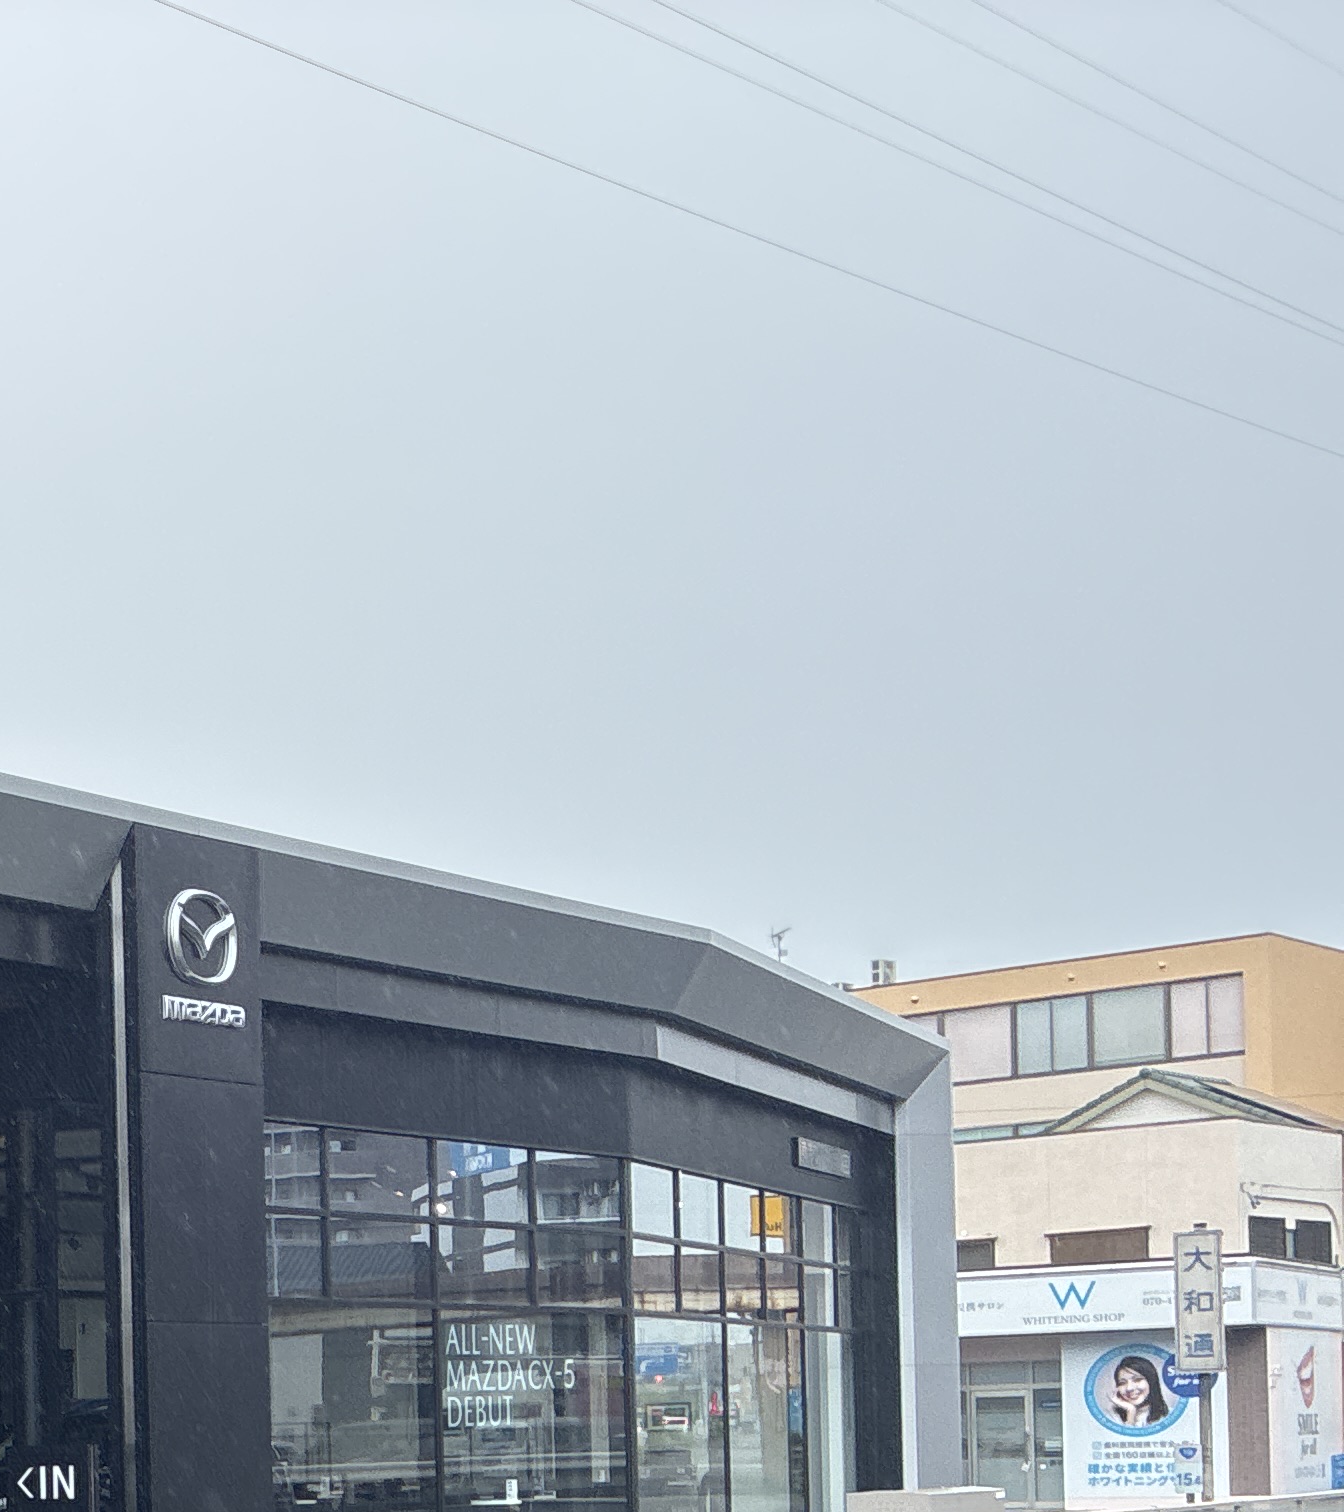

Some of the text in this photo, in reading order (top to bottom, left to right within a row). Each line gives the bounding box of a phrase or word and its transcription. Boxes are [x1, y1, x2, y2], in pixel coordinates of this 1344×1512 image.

[162, 995, 247, 1028] mazda
[1048, 1280, 1097, 1311] W
[1183, 1246, 1215, 1358] 大和通
[1023, 1312, 1125, 1326] WHITENING SHOP
[445, 1323, 536, 1355] ALL-NEW
[447, 1395, 513, 1428] DEBUT
[39, 1464, 75, 1500] IN
